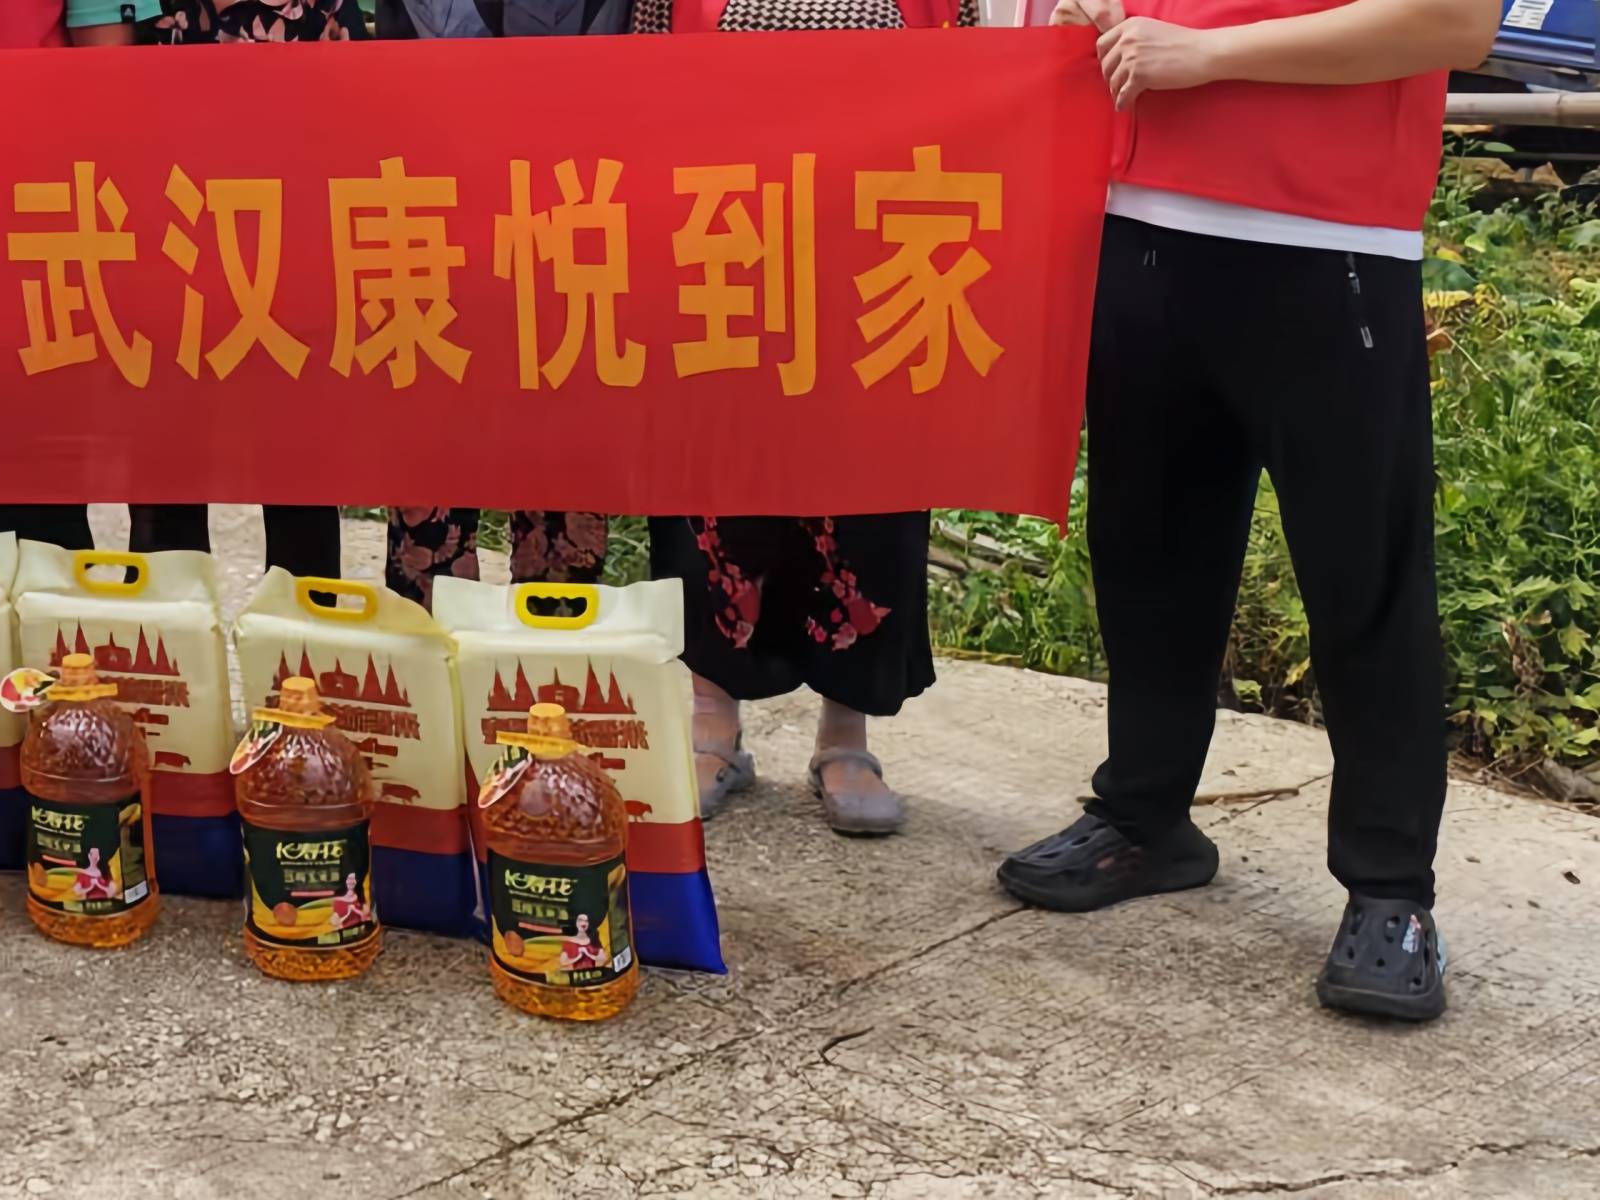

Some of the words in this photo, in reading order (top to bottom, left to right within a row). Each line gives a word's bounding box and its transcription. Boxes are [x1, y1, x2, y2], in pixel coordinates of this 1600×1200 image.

[7, 144, 1005, 397] 武汉康悦到家
